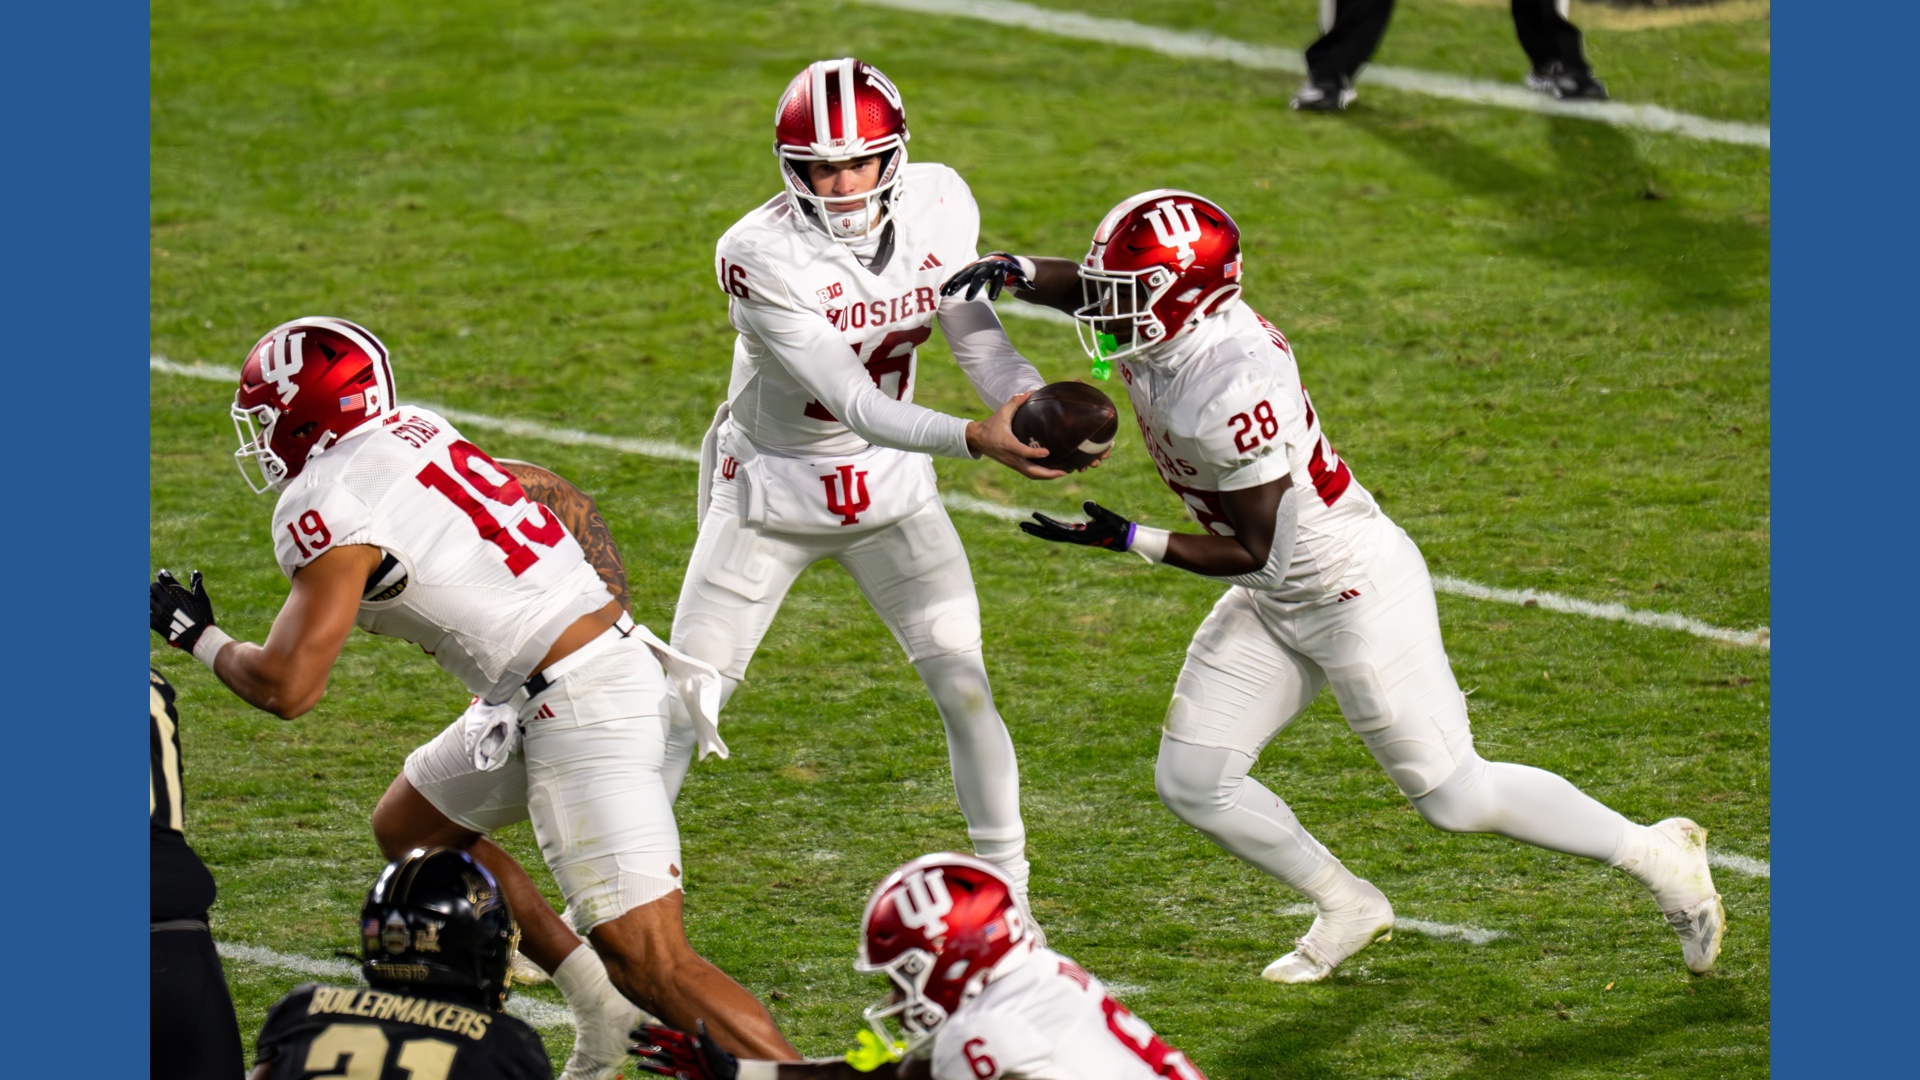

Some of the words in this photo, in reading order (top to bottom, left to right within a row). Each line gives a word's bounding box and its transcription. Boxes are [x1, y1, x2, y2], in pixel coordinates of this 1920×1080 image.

[721, 257, 750, 299] 16
[825, 283, 945, 332] HOOSIER
[1228, 399, 1279, 455] 28
[416, 439, 567, 578] 19
[820, 464, 871, 526] IU
[286, 508, 333, 560] 19
[307, 986, 492, 1041] BOILERMAKERS
[963, 1036, 996, 1080] 6
